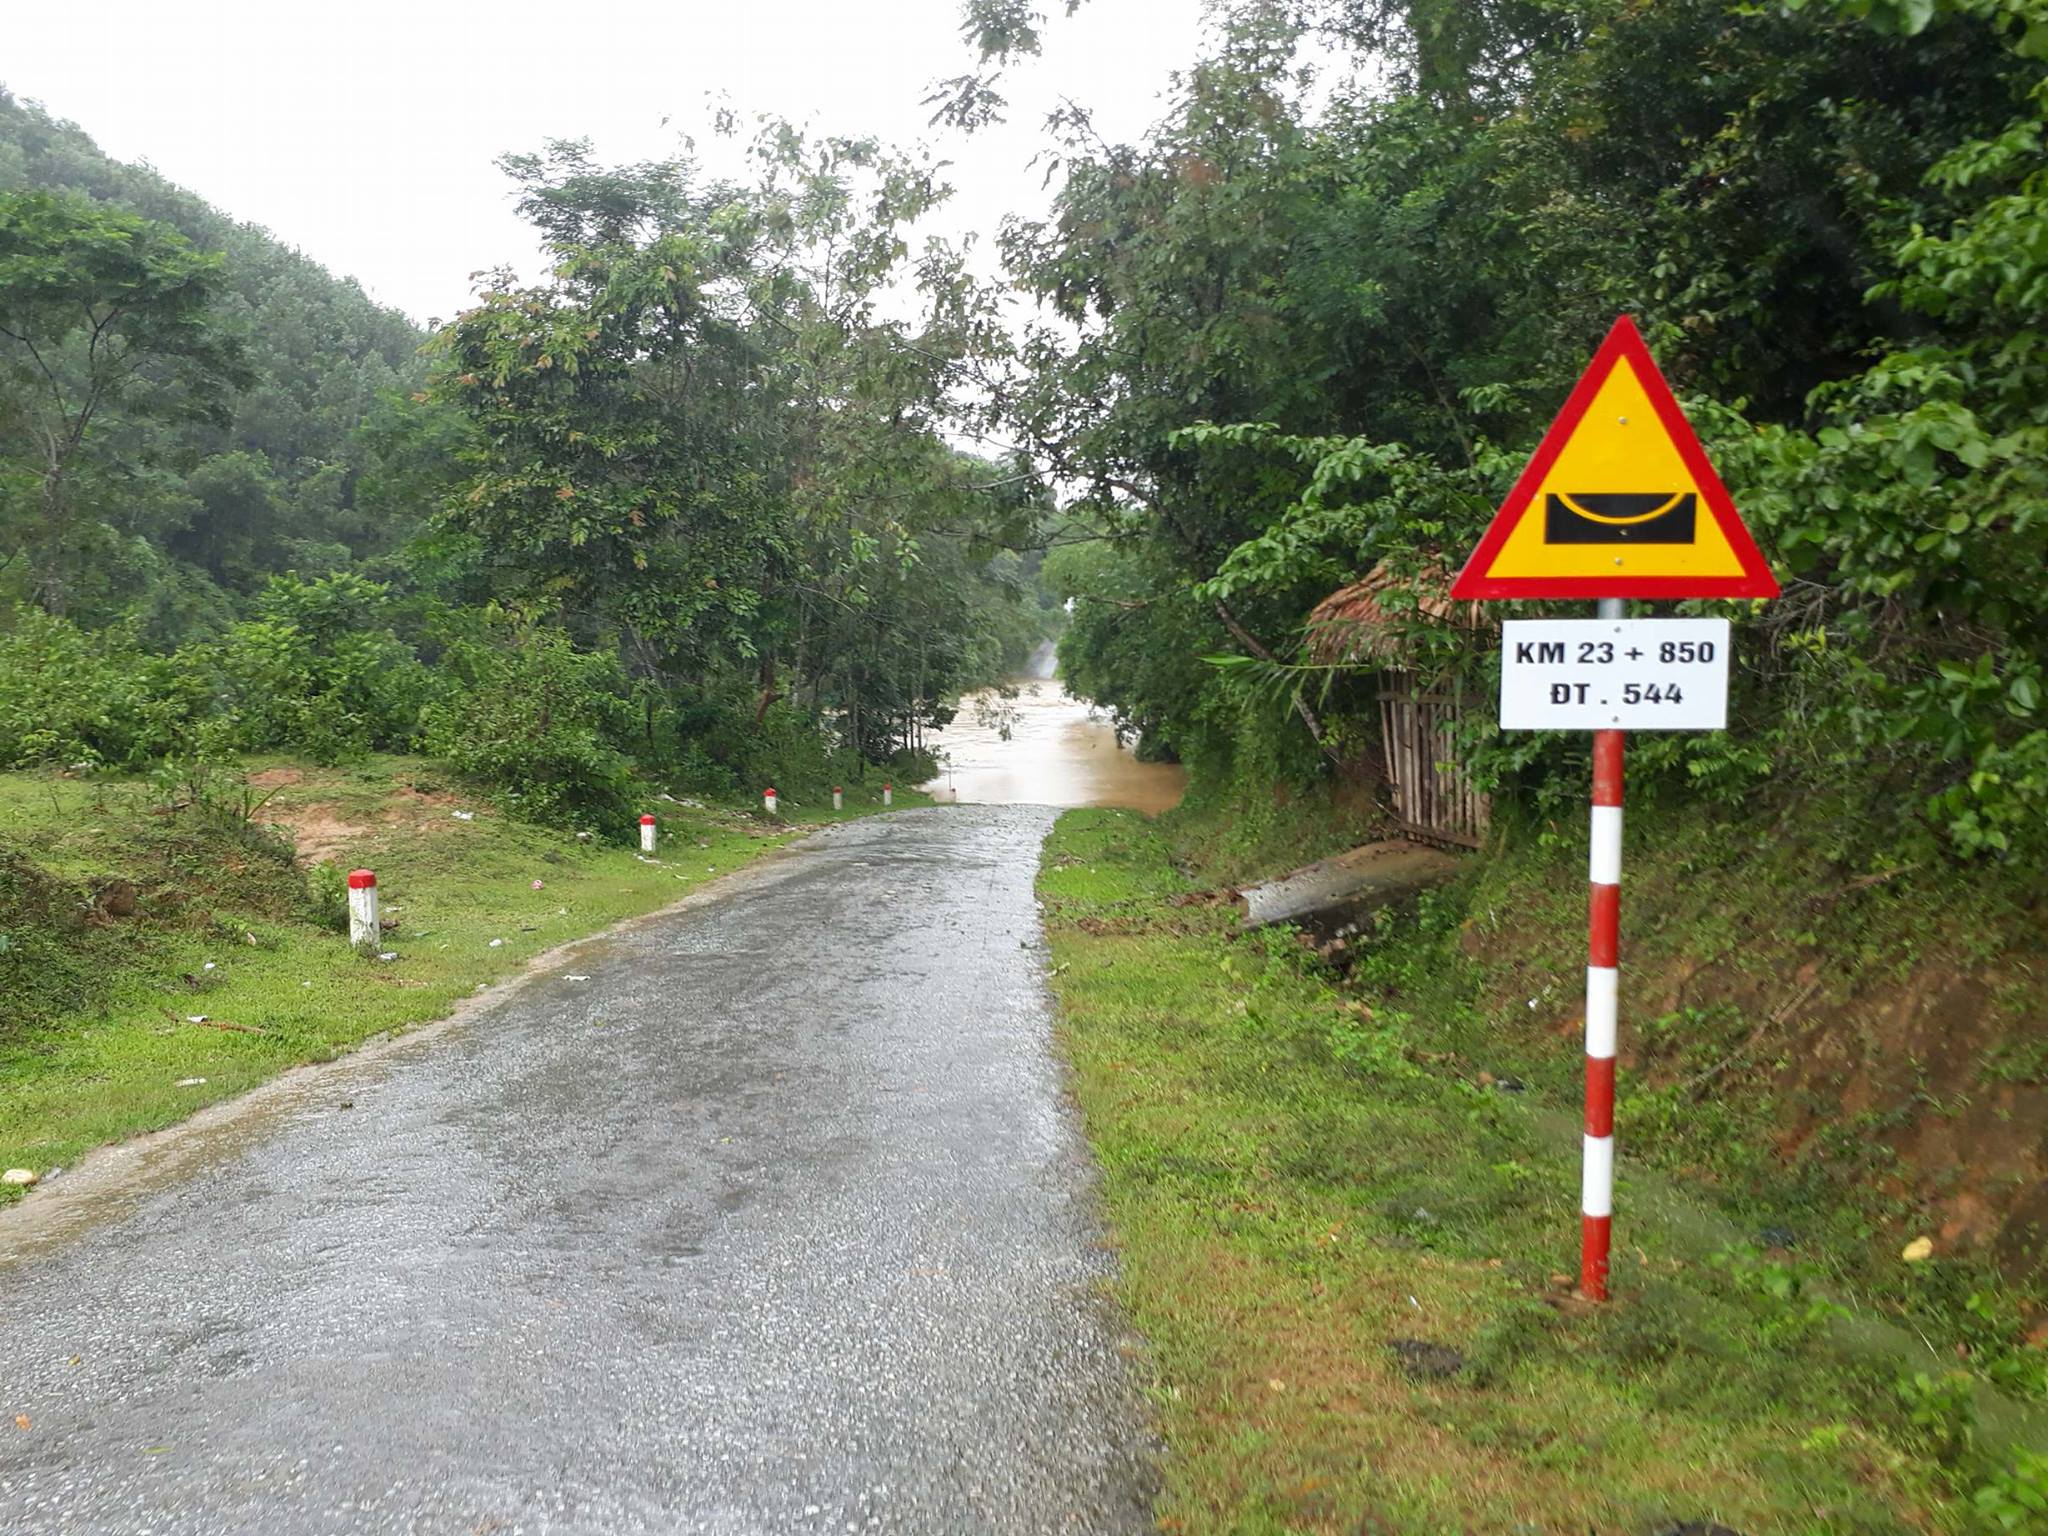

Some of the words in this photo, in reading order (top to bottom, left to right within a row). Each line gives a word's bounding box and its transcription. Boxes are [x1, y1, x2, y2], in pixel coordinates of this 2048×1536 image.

[1516, 642, 1565, 664] KM
[1577, 642, 1614, 664] 23
[1659, 641, 1715, 664] 850
[1623, 683, 1683, 705] 544
